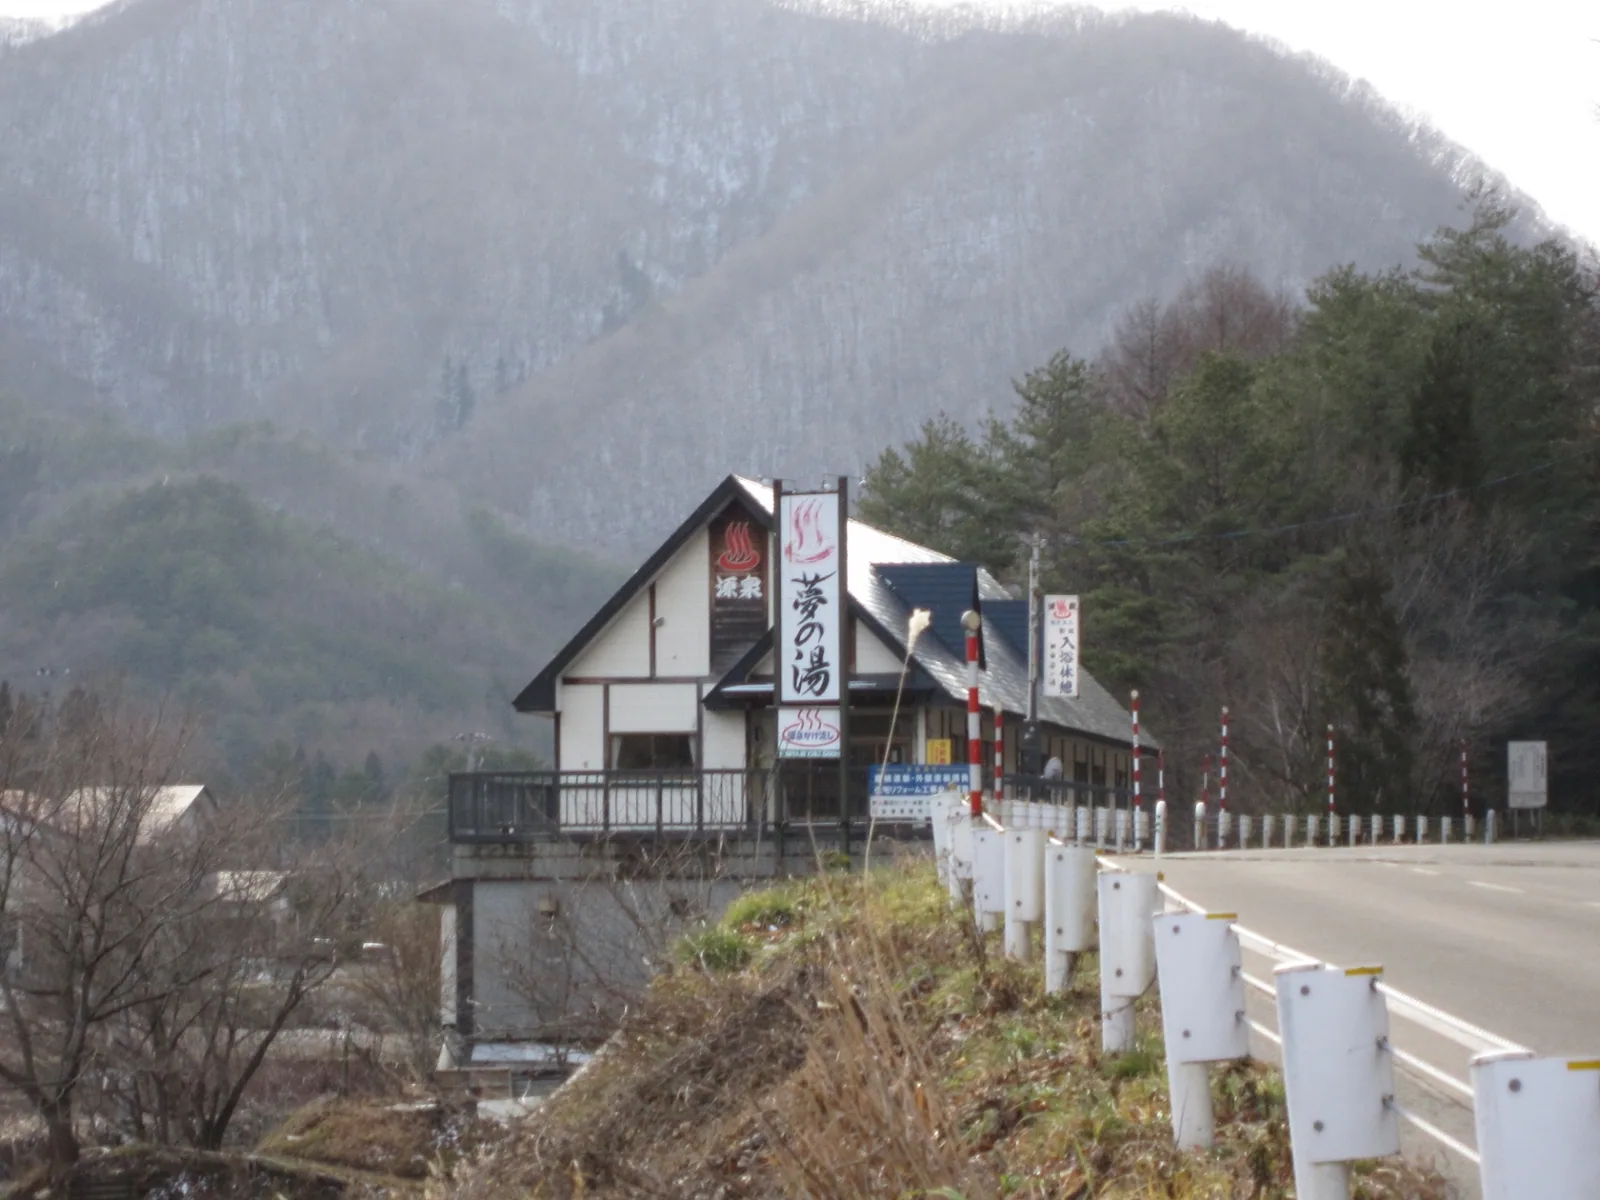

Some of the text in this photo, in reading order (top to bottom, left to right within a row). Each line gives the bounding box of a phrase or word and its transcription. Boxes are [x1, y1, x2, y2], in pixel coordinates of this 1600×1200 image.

[715, 574, 763, 599] 源泉
[791, 570, 837, 697] 夢の湯
